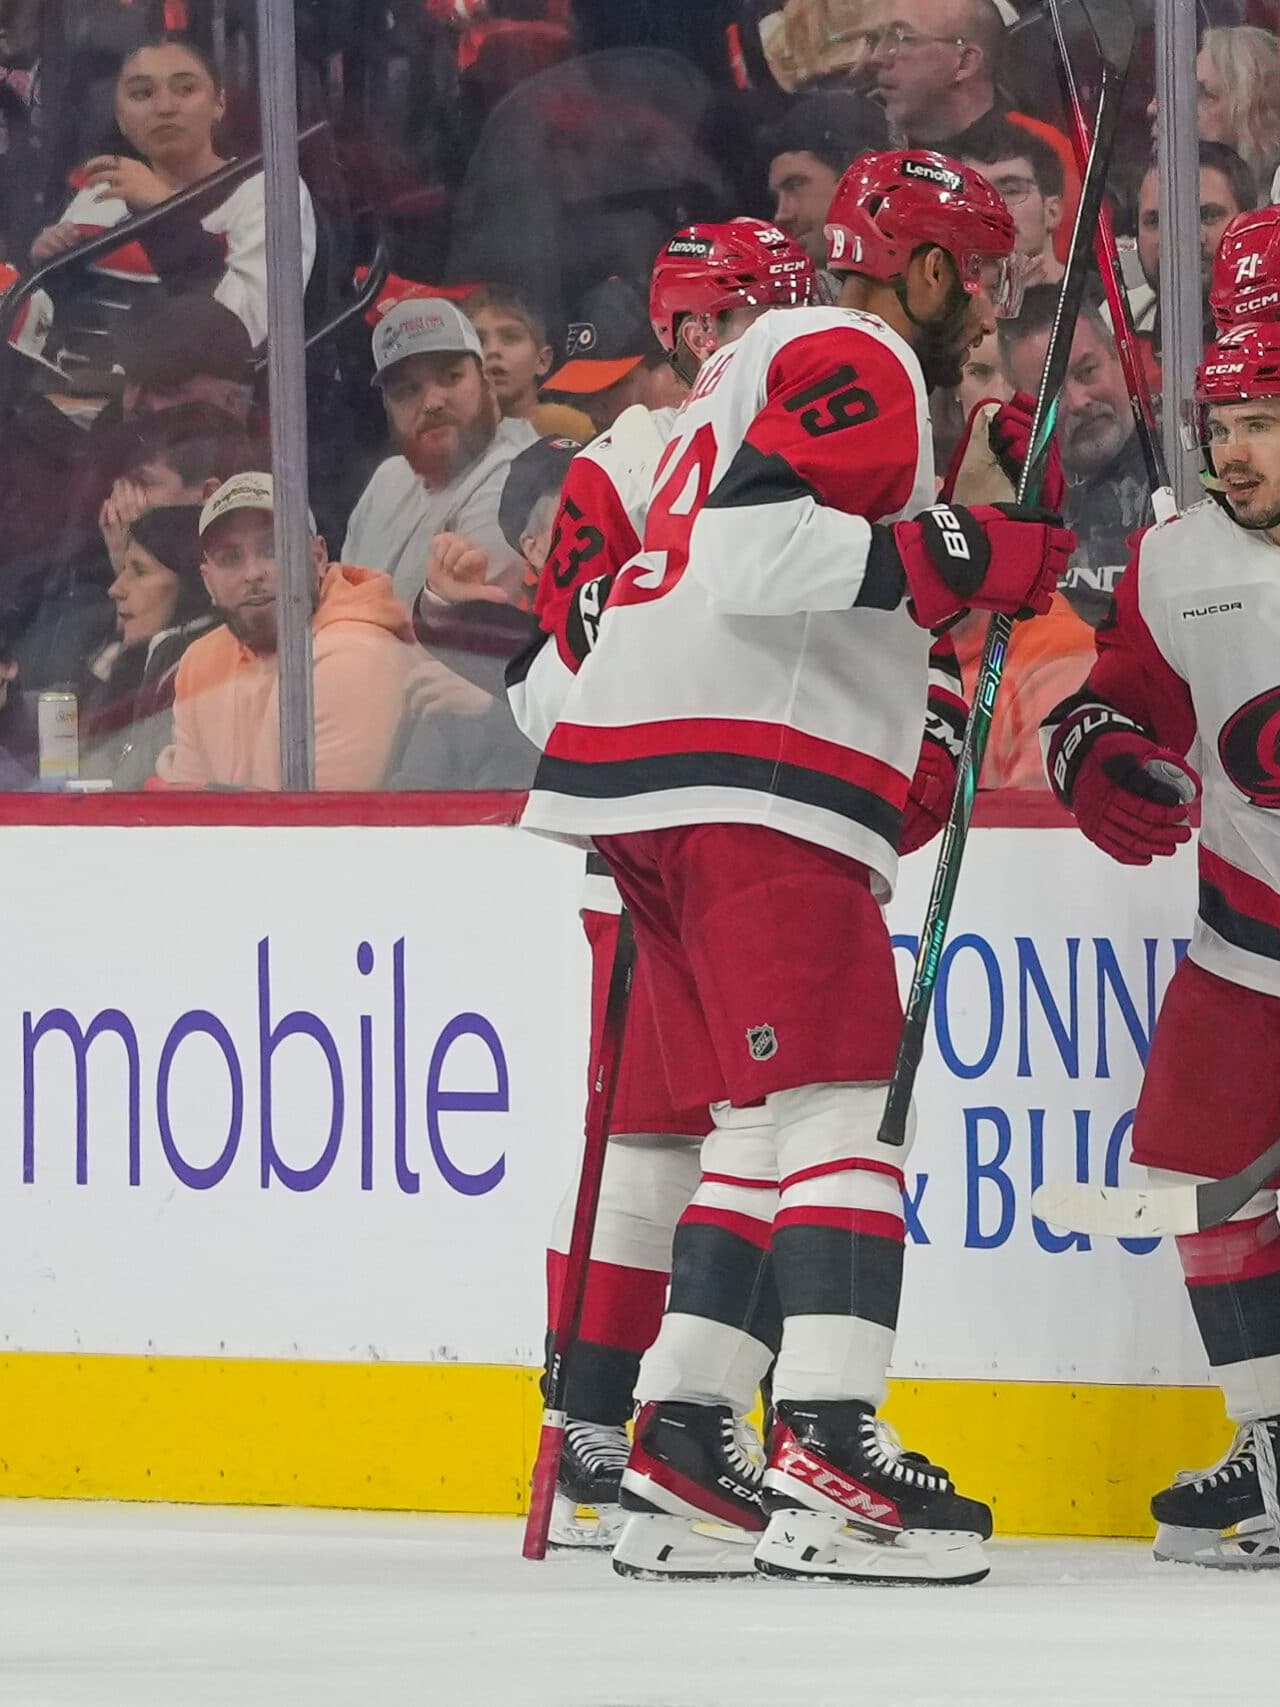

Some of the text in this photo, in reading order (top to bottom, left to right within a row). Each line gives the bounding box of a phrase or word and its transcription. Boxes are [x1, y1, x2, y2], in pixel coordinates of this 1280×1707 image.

[906, 162, 961, 190] Lenovo
[668, 240, 706, 254] Lenovo
[769, 260, 806, 274] CCM
[1235, 292, 1279, 315] CCM
[1205, 363, 1245, 375] CCM
[783, 365, 880, 438] 19
[1182, 601, 1243, 619] NUCOR
[22, 935, 510, 1196] mobile
[779, 1448, 893, 1519] CCM
